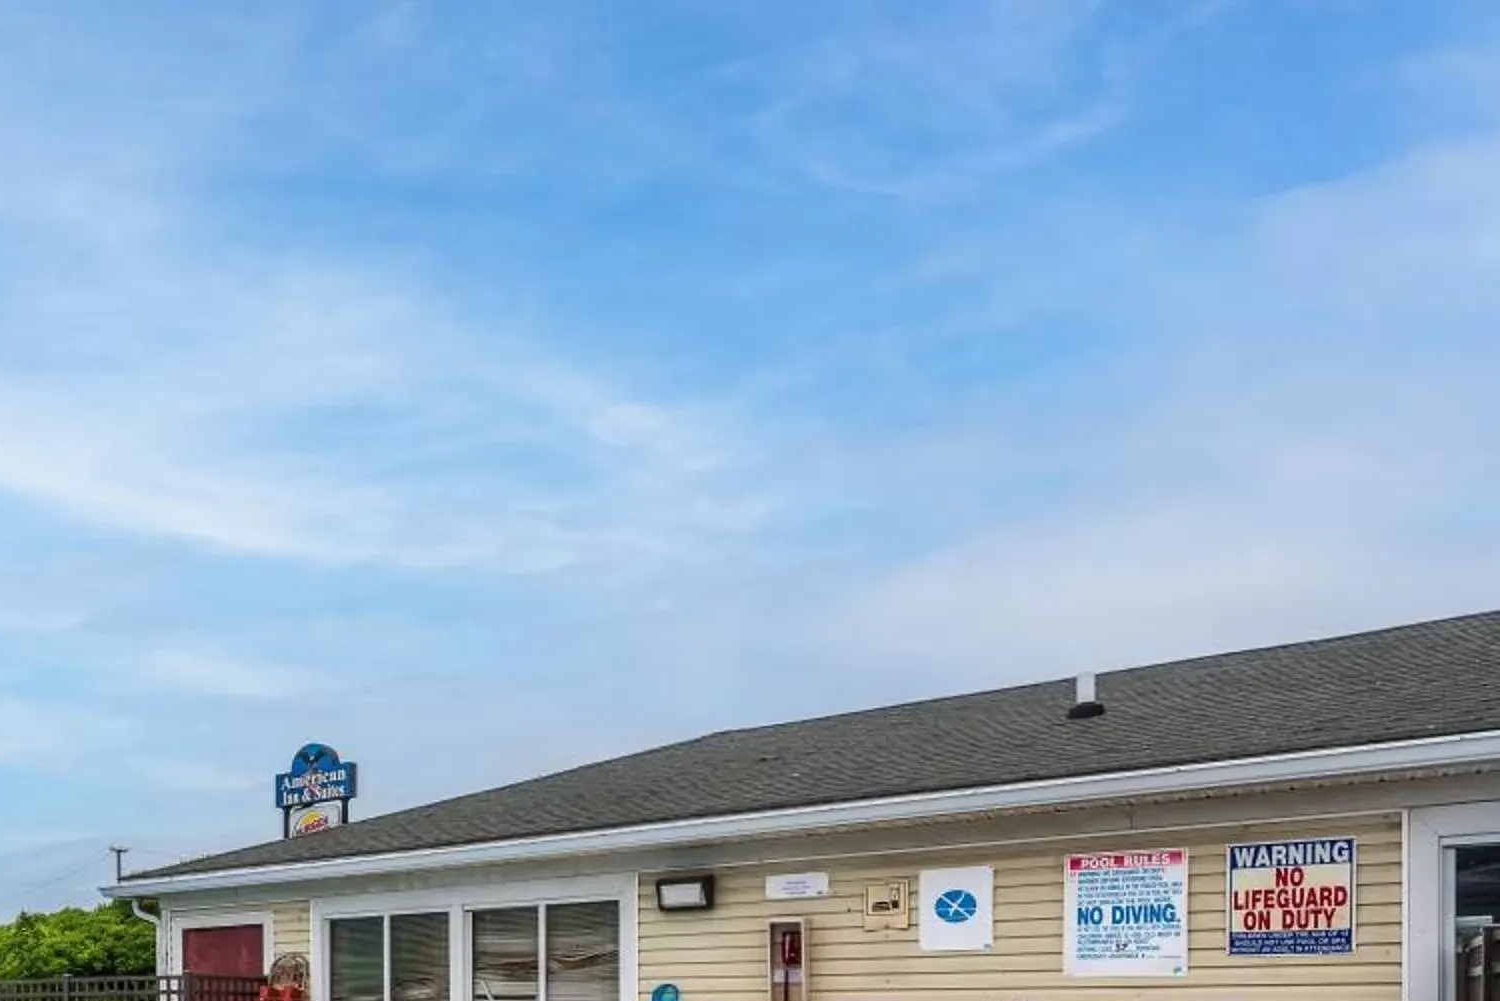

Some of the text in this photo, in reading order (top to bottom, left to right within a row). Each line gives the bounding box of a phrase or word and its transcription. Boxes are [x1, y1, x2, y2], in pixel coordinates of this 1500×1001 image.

[281, 769, 347, 789] American
[283, 791, 299, 805] Inn
[313, 784, 346, 800] Suites
[1081, 853, 1170, 869] POOL RULES
[1234, 842, 1349, 867] WARNING
[1275, 868, 1304, 887] NO
[1234, 886, 1348, 910] LIFEGUARD
[1077, 904, 1181, 925] NO DIVING.
[1244, 908, 1336, 930] ON DUTY
